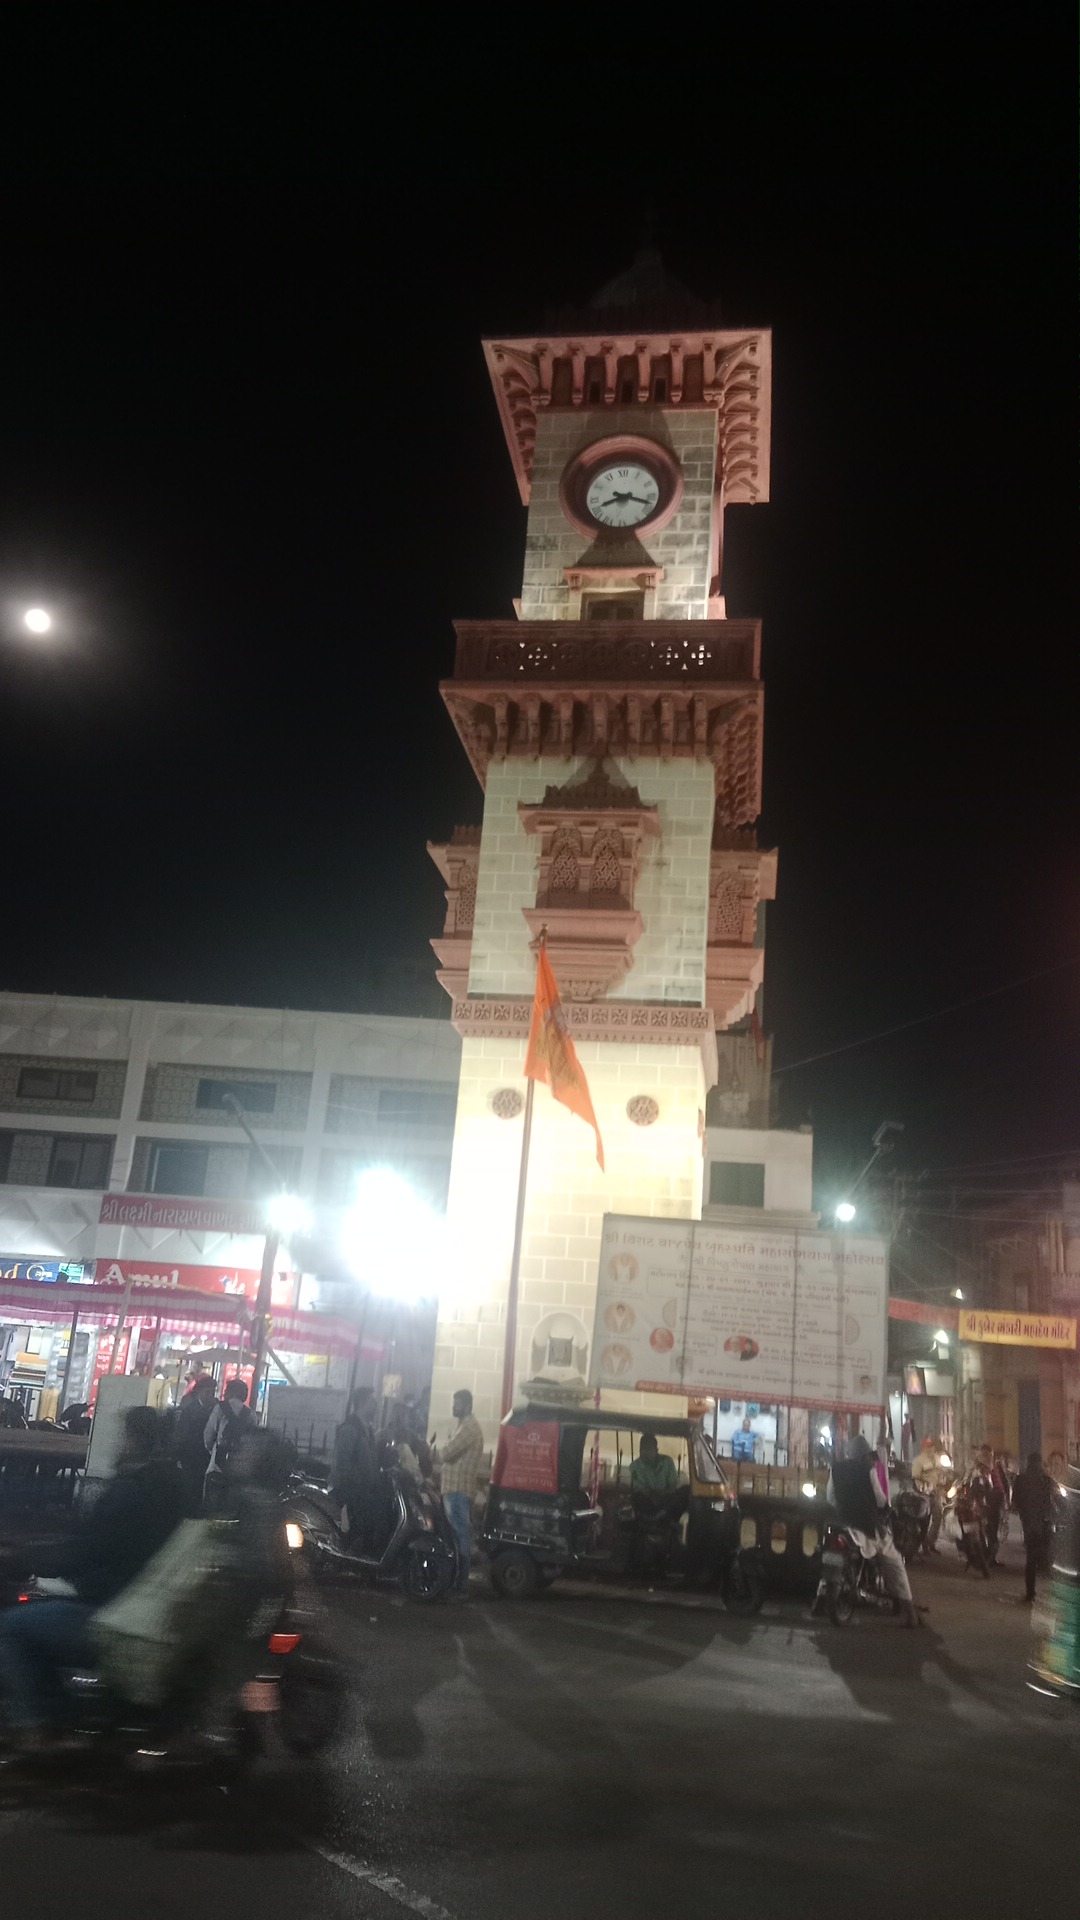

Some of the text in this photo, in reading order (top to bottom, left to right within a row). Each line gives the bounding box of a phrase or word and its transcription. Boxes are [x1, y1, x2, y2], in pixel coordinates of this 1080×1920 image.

[101, 1199, 119, 1221] શ્રી
[153, 1208, 201, 1225] નારાયણ
[100, 1263, 180, 1290] Amul
